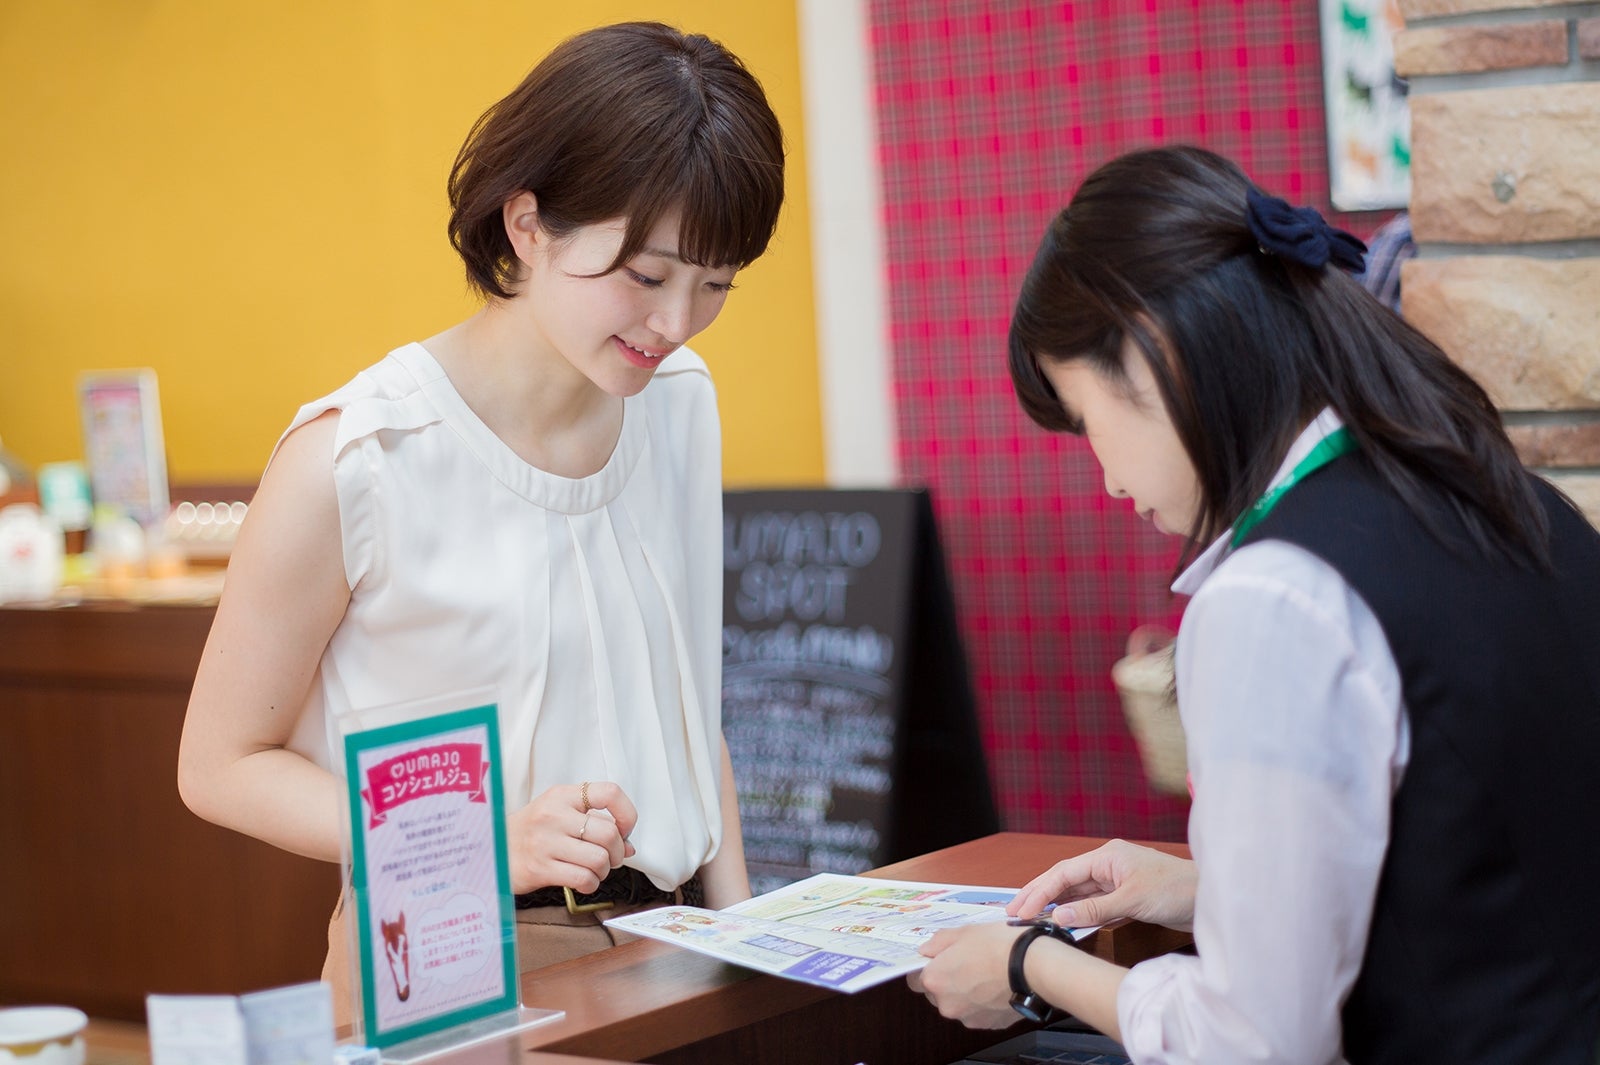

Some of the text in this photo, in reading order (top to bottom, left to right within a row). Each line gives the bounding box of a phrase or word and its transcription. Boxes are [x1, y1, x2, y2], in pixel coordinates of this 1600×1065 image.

[407, 751, 460, 775] UMAJO
[381, 767, 471, 803] コンシェルジュ
